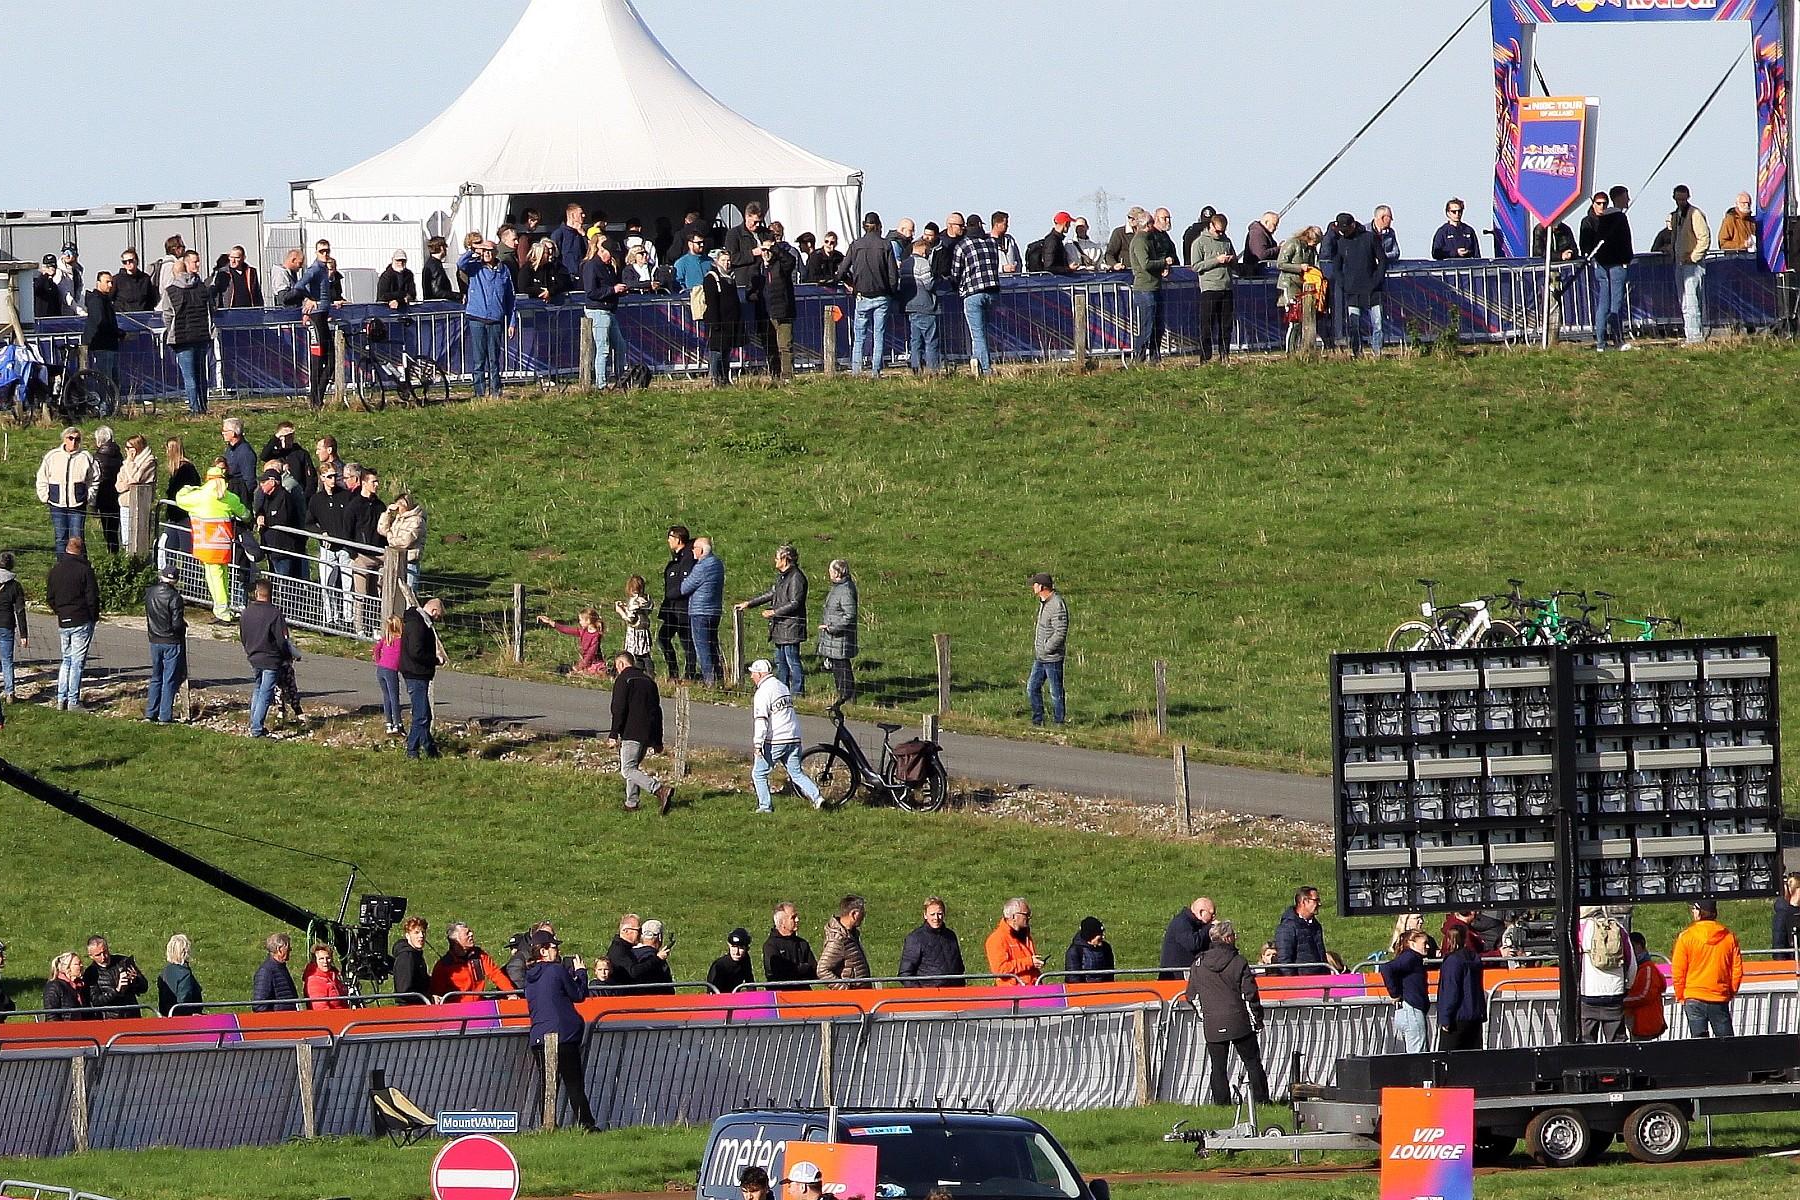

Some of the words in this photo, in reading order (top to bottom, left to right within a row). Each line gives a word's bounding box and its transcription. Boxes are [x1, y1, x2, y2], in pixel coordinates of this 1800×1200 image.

[443, 1117, 515, 1130] MountVAMpad
[1413, 1127, 1445, 1143] VIP
[711, 1125, 786, 1190] metec
[1389, 1144, 1466, 1160] LOUNGE
